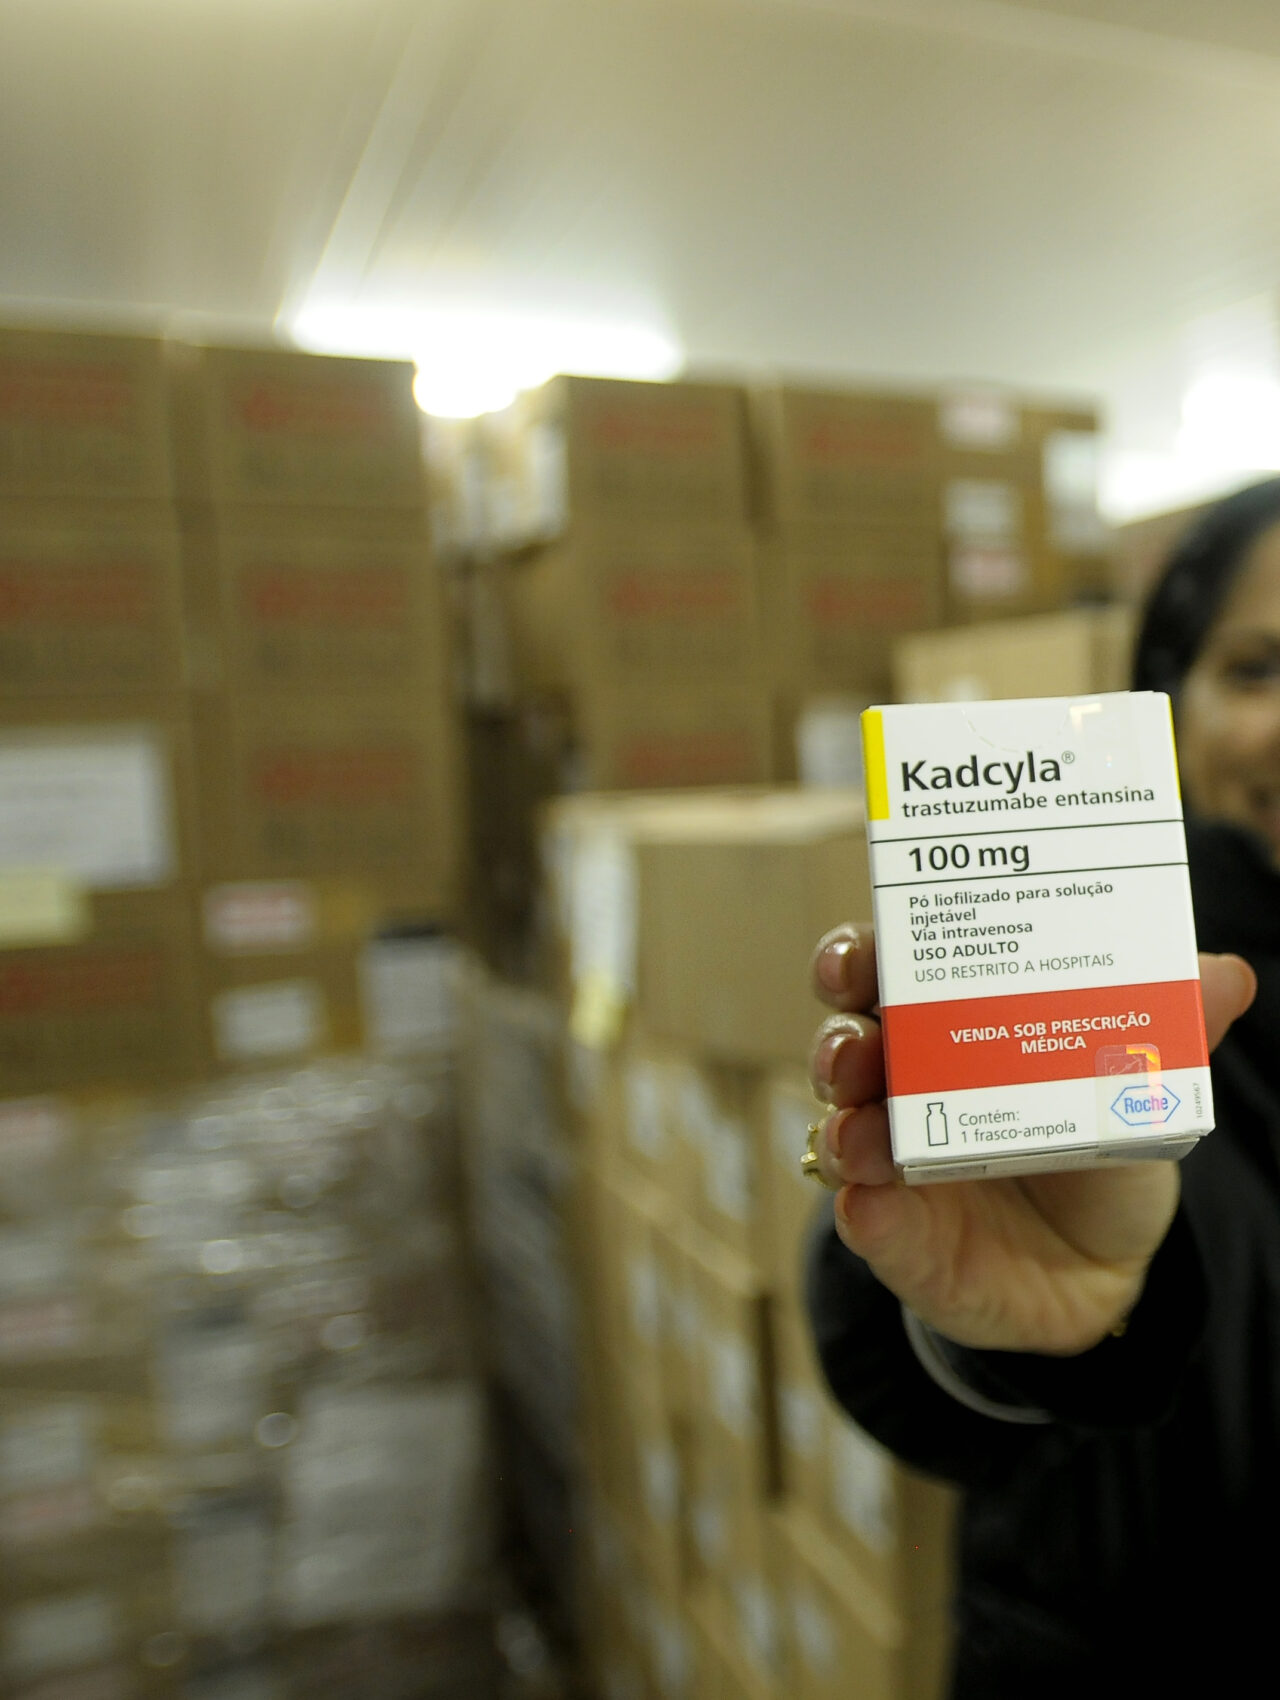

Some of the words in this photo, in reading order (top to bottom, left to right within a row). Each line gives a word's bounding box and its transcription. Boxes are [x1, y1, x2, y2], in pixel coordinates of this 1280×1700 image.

[900, 751, 1075, 793] Kadcyla®
[902, 793, 1048, 818] trastuzumabe
[1055, 787, 1154, 807] entansina
[908, 844, 970, 872] 100
[978, 844, 1030, 872] mg
[909, 893, 929, 908] Pó
[934, 889, 1010, 907] liofilizado
[1016, 887, 1050, 903] para
[1055, 881, 1113, 898] solução
[910, 908, 976, 926] injetável
[912, 928, 937, 942] Via
[942, 921, 1033, 939] intravenosa
[913, 948, 947, 961] USO
[952, 941, 1019, 959] ADULTO
[915, 968, 946, 983] USO
[952, 962, 1019, 979] RESTRITO
[1024, 960, 1035, 972] A
[1040, 954, 1114, 971] HOSPITAIS
[950, 1026, 1009, 1043] VENDA
[1014, 1023, 1046, 1038] SOB
[1051, 1012, 1150, 1035] PRESCRIÇÃO
[1022, 1035, 1086, 1054] MÉDICA
[1124, 1096, 1168, 1114] Roche
[959, 1109, 1020, 1127] Contém:
[961, 1131, 968, 1143] 1
[974, 1121, 1076, 1142] frasco-ampola
